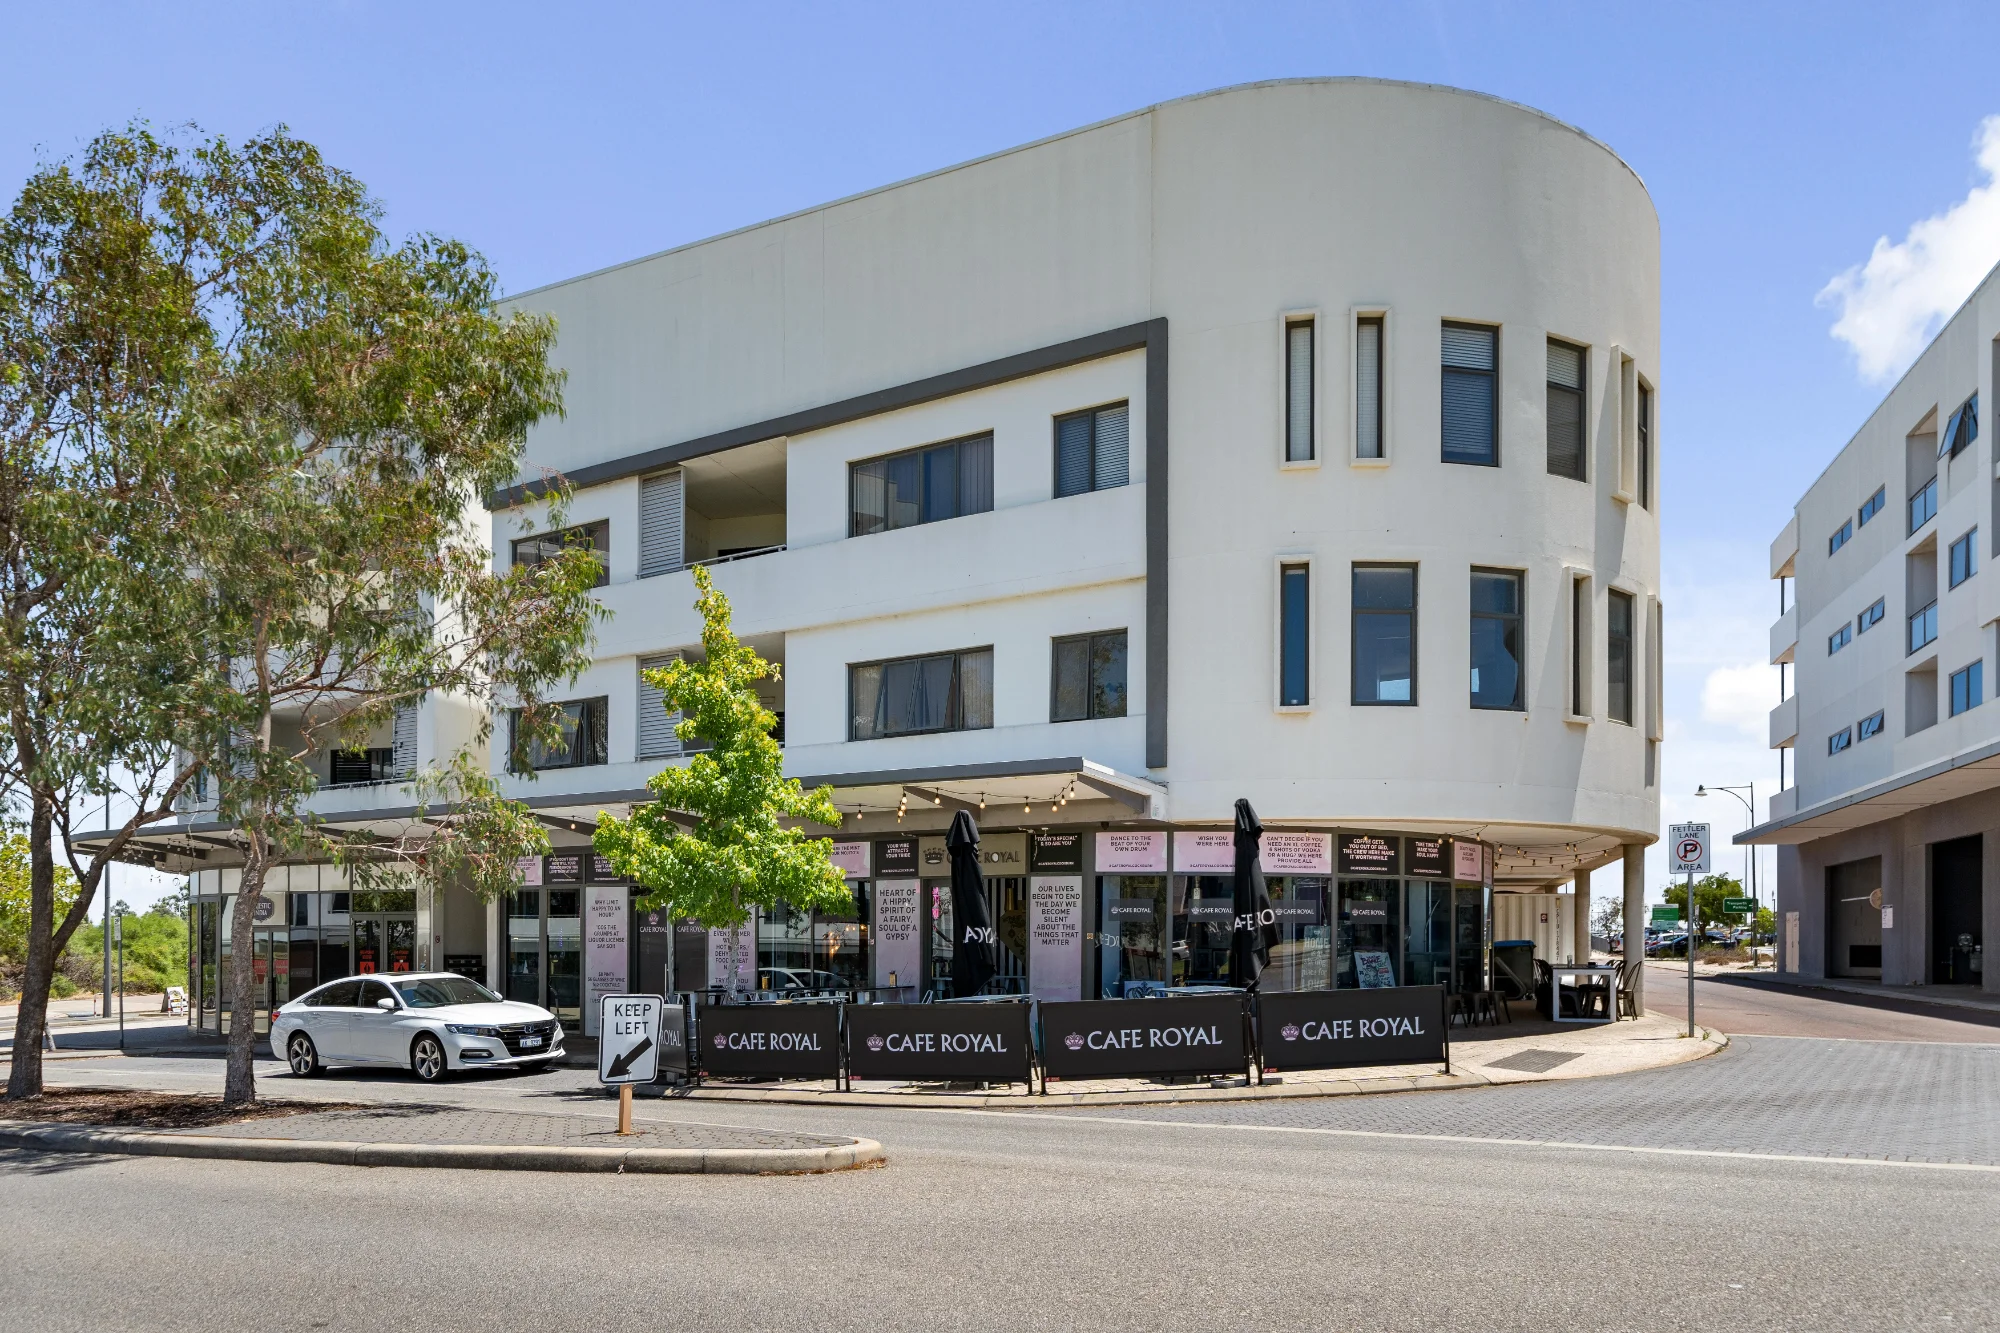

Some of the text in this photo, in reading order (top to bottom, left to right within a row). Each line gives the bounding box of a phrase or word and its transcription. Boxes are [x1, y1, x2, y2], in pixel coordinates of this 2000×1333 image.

[984, 851, 1020, 864] ROYAL
[1677, 863, 1703, 871] AREA
[879, 889, 905, 897] HEART
[889, 897, 914, 906] HIPPY,
[880, 906, 916, 914] SPIRIT OF
[890, 915, 913, 924] FAIRY,
[878, 924, 899, 932] SOUL
[885, 933, 910, 941] GYPSY
[1304, 937, 1331, 949] HOME
[614, 1004, 652, 1017] KEEP
[615, 1021, 649, 1035] LEFT
[1301, 1016, 1425, 1041] CAFE ROYAL
[728, 1032, 822, 1051] CAFE ROYAL
[886, 1033, 1008, 1053] CAFE ROYAL
[1087, 1025, 1223, 1050] CAFE ROYAL
